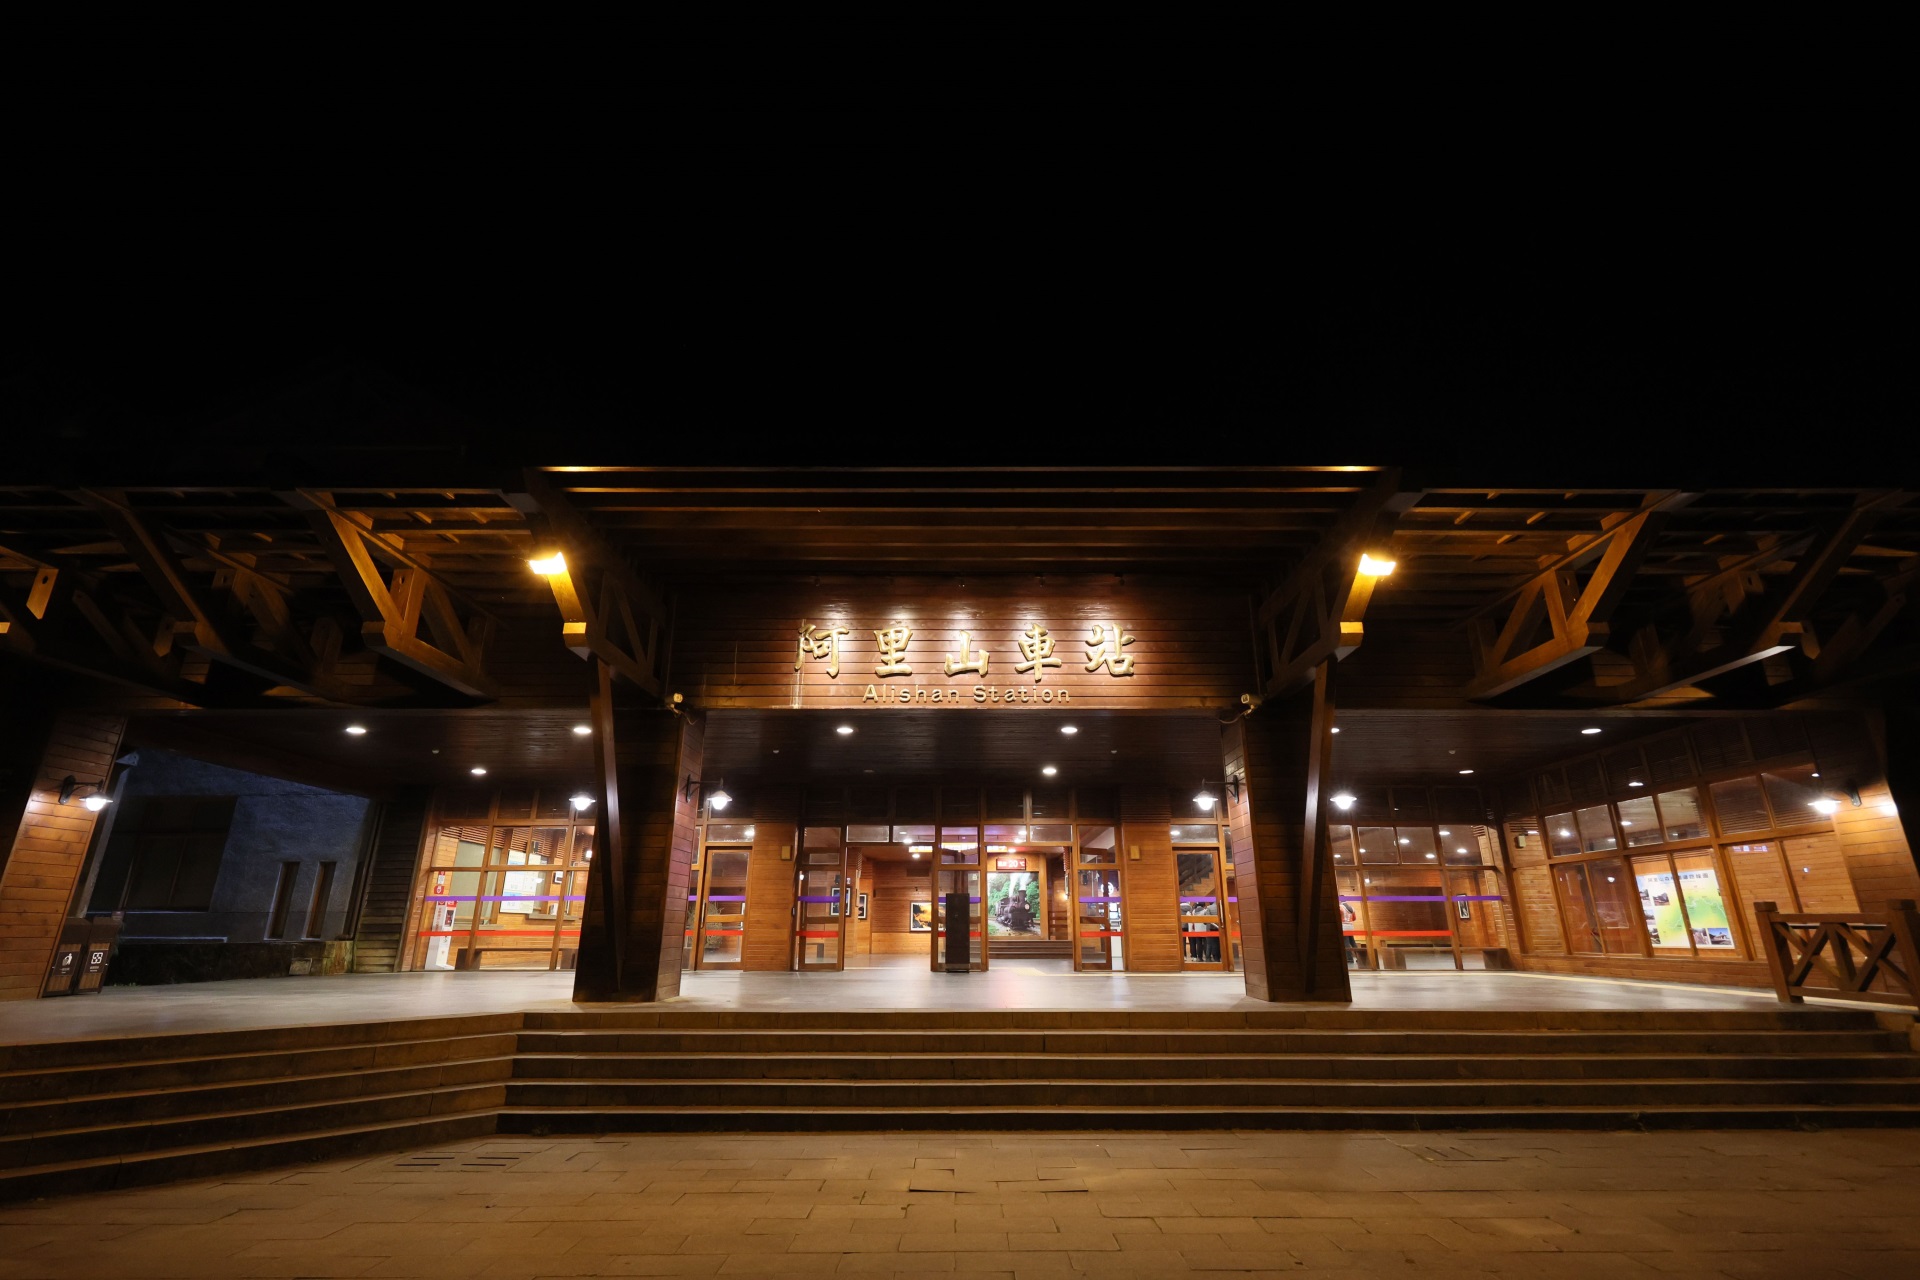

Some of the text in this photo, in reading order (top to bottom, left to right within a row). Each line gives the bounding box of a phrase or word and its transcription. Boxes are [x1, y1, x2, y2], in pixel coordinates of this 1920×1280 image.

[794, 622, 1136, 682] 阿里山車站
[862, 684, 1071, 703] Alishan Station
